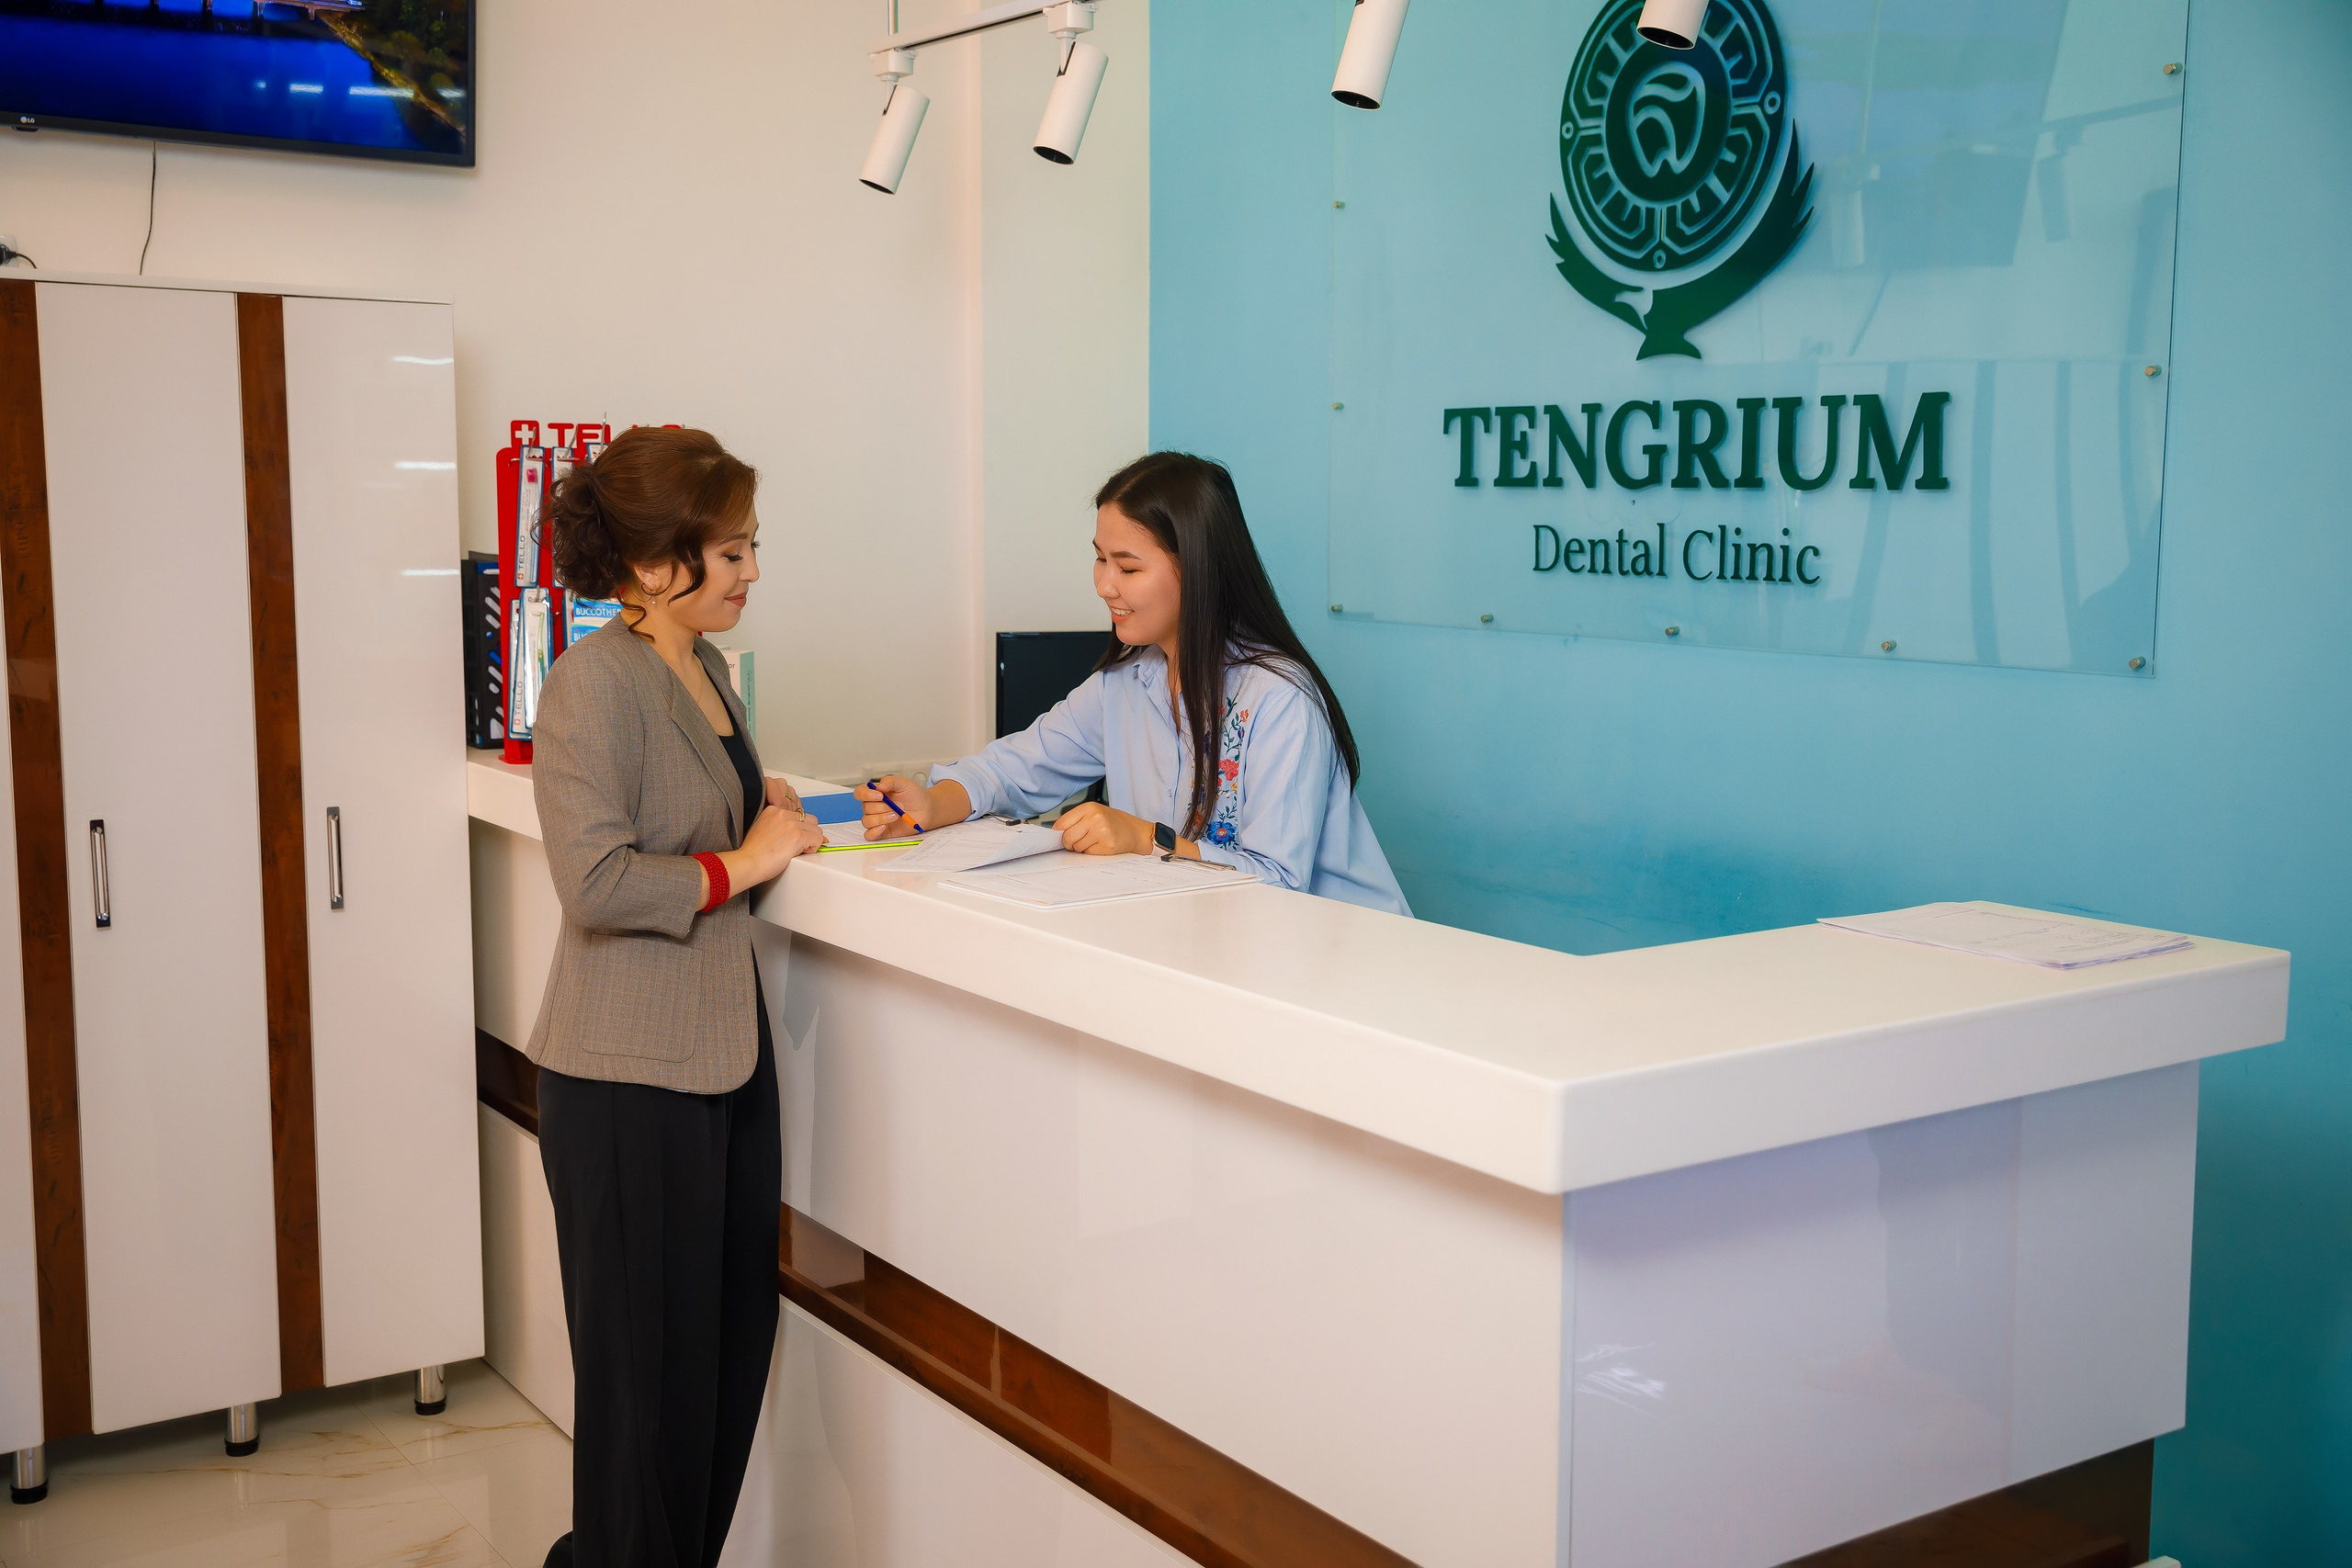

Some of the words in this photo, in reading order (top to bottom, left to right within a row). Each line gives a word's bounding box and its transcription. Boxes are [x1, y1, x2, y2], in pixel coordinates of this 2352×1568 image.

[1443, 391, 1951, 491] TENGRIUM
[518, 535, 526, 570] TELLO
[1532, 523, 1668, 578] Dental
[1682, 524, 1821, 585] Clinic
[514, 681, 524, 716] TELLO
